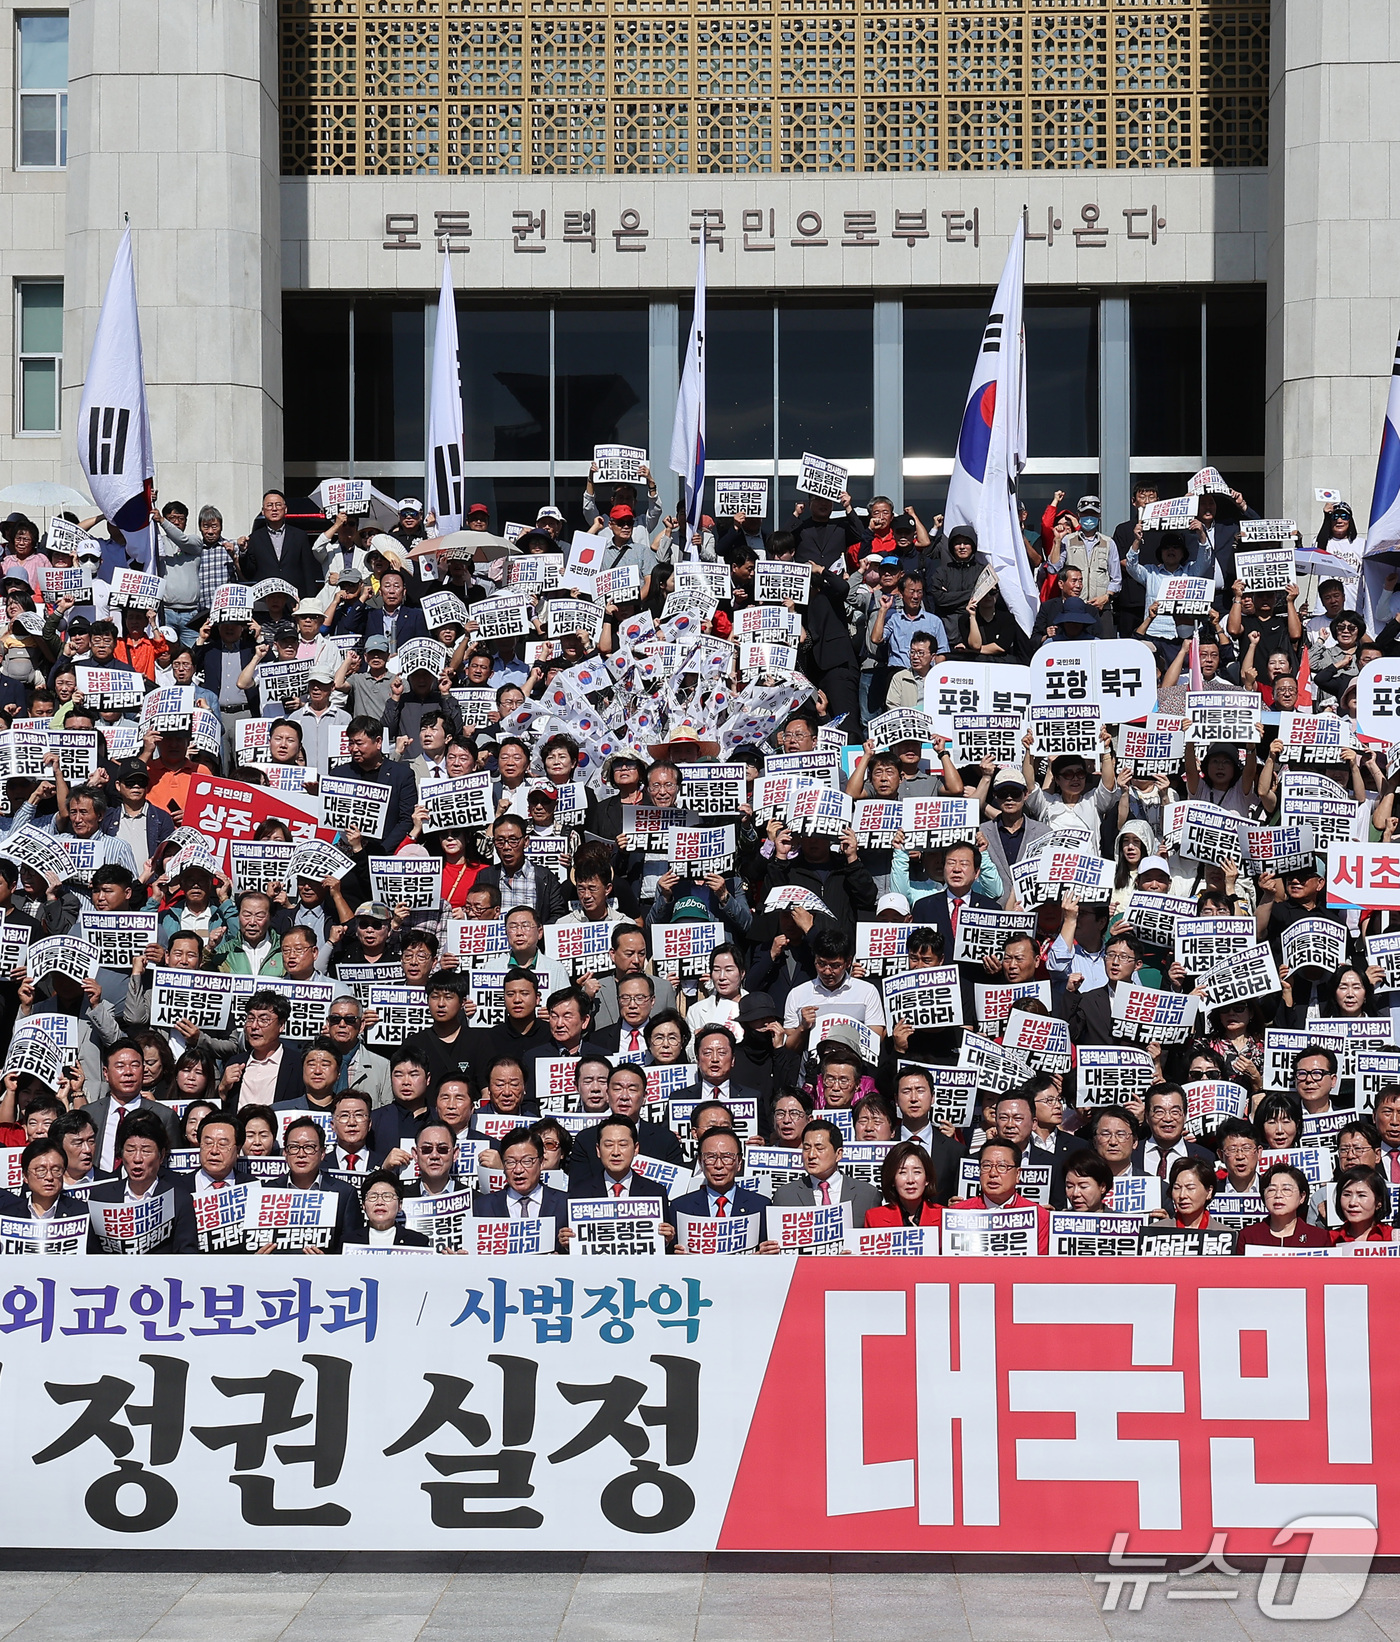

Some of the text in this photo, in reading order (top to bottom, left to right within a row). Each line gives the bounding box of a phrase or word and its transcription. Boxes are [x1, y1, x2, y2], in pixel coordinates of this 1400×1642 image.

[383, 203, 1166, 253] 모든 권력은 국민으로부터 나온다
[598, 459, 641, 470] 대통령은
[804, 455, 847, 477] 정책실패·인사참사
[599, 469, 642, 481] 사죄하라
[804, 468, 843, 486] 대통령은
[328, 482, 364, 492] 민생파탄
[718, 481, 765, 492] 정책실패·인사참사
[802, 479, 841, 499] 사죄하라
[329, 492, 364, 502] 헌정파괴
[719, 492, 761, 503] 대통령은
[1153, 498, 1190, 510] 민생파탄
[1151, 507, 1188, 517] 헌정파괴
[1142, 518, 1195, 530] 강력 규탄한다
[1237, 552, 1292, 564] 정책실패·인사참사
[45, 569, 83, 580] 민생파탄
[757, 564, 809, 577] 정책실패·인사참사
[1242, 566, 1288, 578] 대통령은
[45, 579, 82, 590] 헌정파괴
[122, 573, 161, 586] 민생파탄
[760, 575, 805, 588] 대통령은
[1168, 580, 1206, 588] 민생파탄
[1243, 577, 1289, 591] 사죄하라
[120, 582, 160, 596] 헌정파괴
[760, 588, 804, 601] 사죄하라
[1166, 589, 1205, 599] 헌정파괴
[109, 592, 126, 606] 강력
[471, 597, 524, 613] 정책실패·인사참사
[1158, 601, 1212, 614] 강력 규탄한다
[473, 607, 518, 625] 대통령은
[553, 610, 597, 625] 대통령은
[742, 607, 781, 621] 민생파탄
[475, 620, 523, 638] 사죄하라
[741, 619, 780, 631] 헌정파괴
[261, 660, 314, 674] 정책실패·인사참사
[87, 671, 132, 682] 민생파탄
[265, 677, 308, 690] 대통령은
[1046, 668, 1142, 699] 포항 북구
[88, 681, 133, 692] 헌정파괴
[102, 693, 143, 706] 규탄한다
[939, 689, 1032, 721] 포항 북구
[1189, 694, 1258, 708] 정책실패·인사참사
[1033, 706, 1100, 719] 정책실패·인사참사
[1192, 709, 1253, 724] 대통령은
[955, 715, 1020, 729] 정책실패·인사참사
[1036, 719, 1096, 736] 대통령은
[1292, 717, 1341, 731] 민생파탄
[875, 730, 930, 748] 사죄하라
[958, 731, 1015, 745] 대통령은
[1126, 732, 1172, 743] 민생파탄
[1192, 725, 1253, 740] 사죄하라
[1290, 731, 1339, 745] 헌정파괴
[1034, 736, 1096, 753] 사죄하라
[1125, 743, 1171, 757] 헌정파괴
[960, 749, 1015, 762] 사죄하라
[1279, 745, 1301, 762] 강력
[768, 754, 835, 771] 정책실패·인사참사
[1116, 758, 1179, 776] 강력 규탄한다
[213, 786, 253, 803] 국민의힘
[322, 784, 388, 799] 정책실패·인사참사
[422, 777, 488, 797] 정책실패·인사참사
[680, 784, 739, 797] 대통령은
[425, 791, 485, 812] 대통령은
[797, 790, 844, 803] 민생파탄
[324, 796, 380, 818] 대통령은
[794, 803, 841, 817] 헌정파괴
[915, 801, 968, 814] 민생파탄
[1284, 801, 1355, 816] 정책실패·인사참사
[199, 803, 318, 841] 상주·경
[324, 813, 378, 834] 사죄하라
[428, 807, 486, 828] 사죄하라
[912, 815, 966, 829] 헌정파괴
[626, 834, 648, 850] 강력
[676, 832, 726, 846] 민생파탄
[905, 832, 927, 848] 강력
[1247, 827, 1300, 845] 민생파탄
[676, 843, 725, 860] 헌정파괴
[1249, 840, 1300, 858] 헌정파괴
[371, 859, 439, 873] 정책실패·인사참사
[1051, 853, 1104, 870] 민생파탄
[1266, 853, 1313, 876] 규탄한다
[376, 877, 433, 893] 대통령은
[1048, 867, 1100, 886] 헌정파괴
[1132, 894, 1197, 916] 정책실패·인사참사
[84, 915, 155, 929] 정책실패·인사참사
[961, 911, 1034, 928] 정책실패·인사참사
[1178, 919, 1253, 935] 정책실패·인사참사
[88, 932, 148, 947] 대통령은
[557, 924, 609, 942] 민생파탄
[664, 926, 716, 943] 민생파탄
[1283, 921, 1344, 942] 정책실패·인사참사
[557, 939, 608, 956] 헌정파괴
[664, 941, 716, 958] 헌정파괴
[1182, 938, 1248, 954] 대통령은
[1286, 935, 1340, 955] 대통령은
[1288, 952, 1339, 971] 사죄하라
[157, 972, 230, 991] 정책실패·인사참사
[884, 972, 956, 991] 정책실패·인사참사
[159, 990, 222, 1008] 대통령은
[890, 987, 951, 1011] 대통령은
[1129, 990, 1188, 1008] 민생파탄
[1125, 1005, 1183, 1024] 헌정파괴
[1112, 1020, 1189, 1044] 강력 규탄한다
[1268, 1033, 1344, 1052] 정책실패·인사참사
[1084, 1068, 1153, 1086] 대통령은
[1188, 1085, 1241, 1100] 민생파탄
[1188, 1099, 1239, 1117] 헌정파괴
[103, 1196, 164, 1223] 민생파탄
[261, 1193, 324, 1210] 민생파탄
[258, 1210, 320, 1226] 헌정파괴
[571, 1204, 659, 1219] 정책실패·인사참사
[782, 1206, 843, 1229] 민생파탄
[2, 1219, 86, 1239] 정책실패·인사참사
[104, 1210, 163, 1239] 헌정파괴
[477, 1219, 542, 1238] 민생파탄
[688, 1218, 749, 1238] 민생파탄
[946, 1211, 1035, 1232] 정책실패·인사참사
[1054, 1217, 1142, 1234] 정책실패·인사참사
[101, 1221, 173, 1254] 강력 규탄한다
[246, 1228, 332, 1250] 강력 규탄한다
[578, 1222, 654, 1240] 대통령은
[781, 1224, 843, 1247] 헌정파괴
[859, 1229, 925, 1251] 민생파탄
[950, 1232, 1028, 1252] 대통령은
[1, 1278, 379, 1344] 외교안보파괴
[450, 1278, 712, 1344] 사법장악
[825, 1283, 1378, 1530] 대국민
[32, 1354, 700, 1533] 정권 실정
